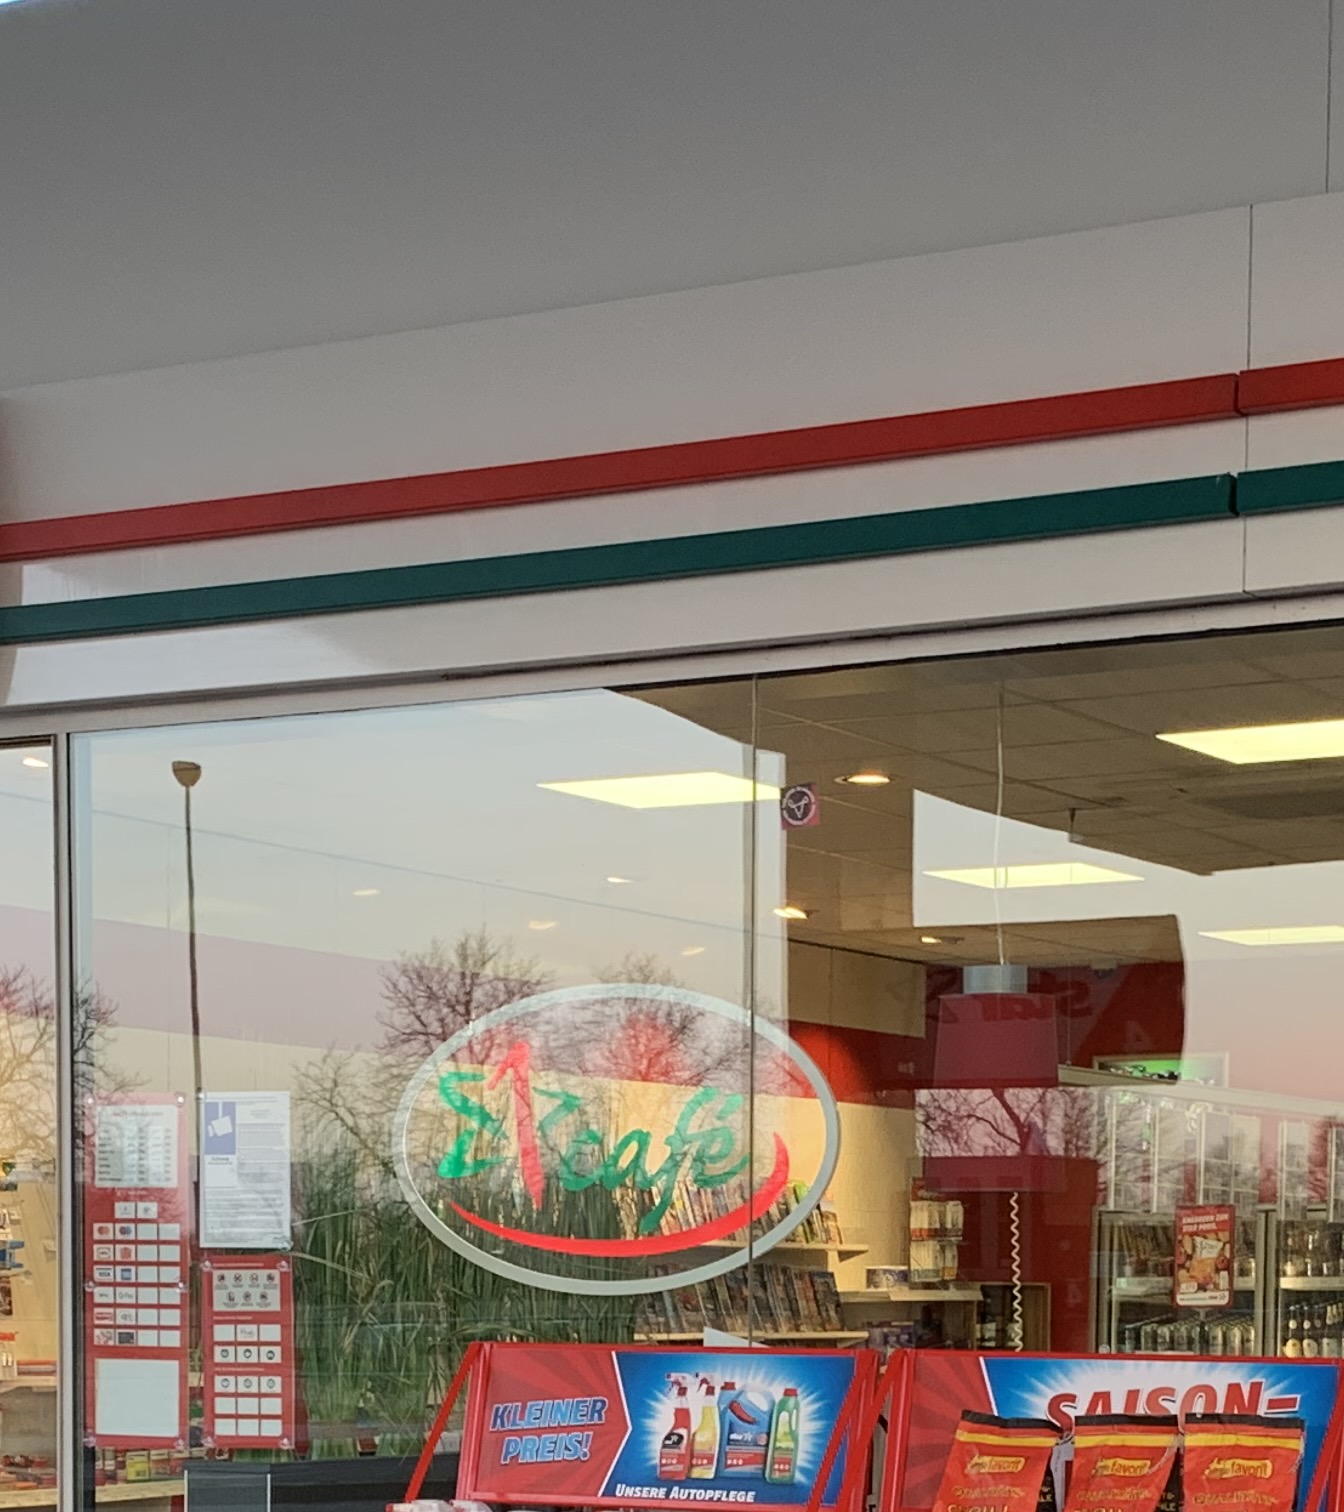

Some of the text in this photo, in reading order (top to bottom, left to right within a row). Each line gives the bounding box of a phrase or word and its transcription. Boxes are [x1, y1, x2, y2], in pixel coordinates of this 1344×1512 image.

[560, 1087, 752, 1233] café
[490, 1396, 608, 1432] KLEINER
[501, 1432, 592, 1466] PREIS!
[615, 1483, 757, 1503] UNSERE AUTOPFLEGE
